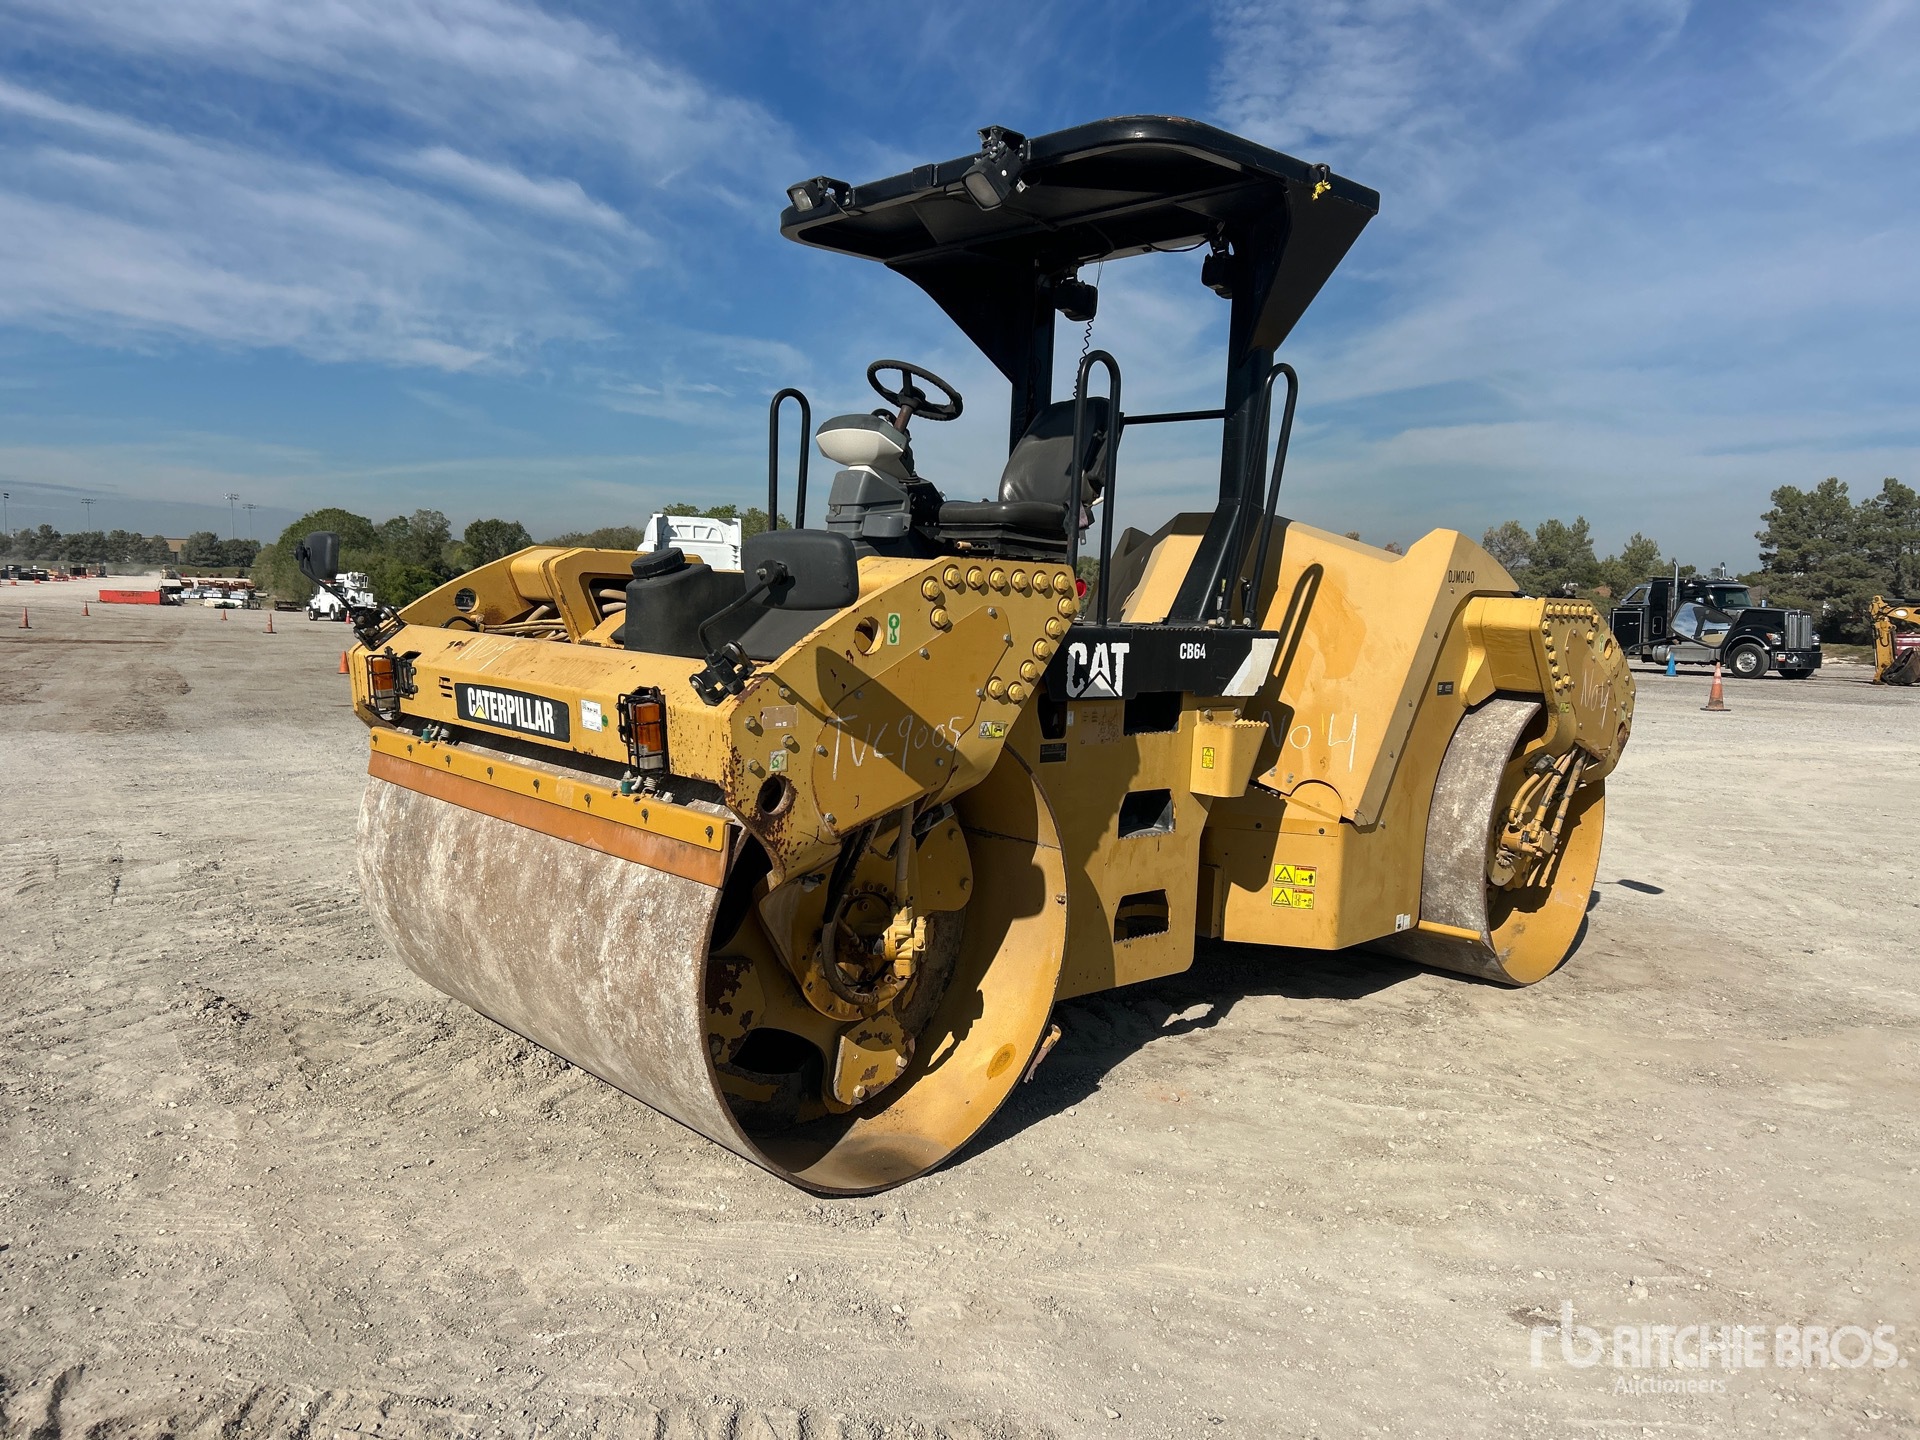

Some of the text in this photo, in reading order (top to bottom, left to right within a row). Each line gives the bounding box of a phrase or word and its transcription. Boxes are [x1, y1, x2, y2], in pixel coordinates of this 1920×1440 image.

[1066, 642, 1130, 698] CAT
[1179, 643, 1207, 660] CB64
[467, 686, 555, 735] CATERPILLAR
